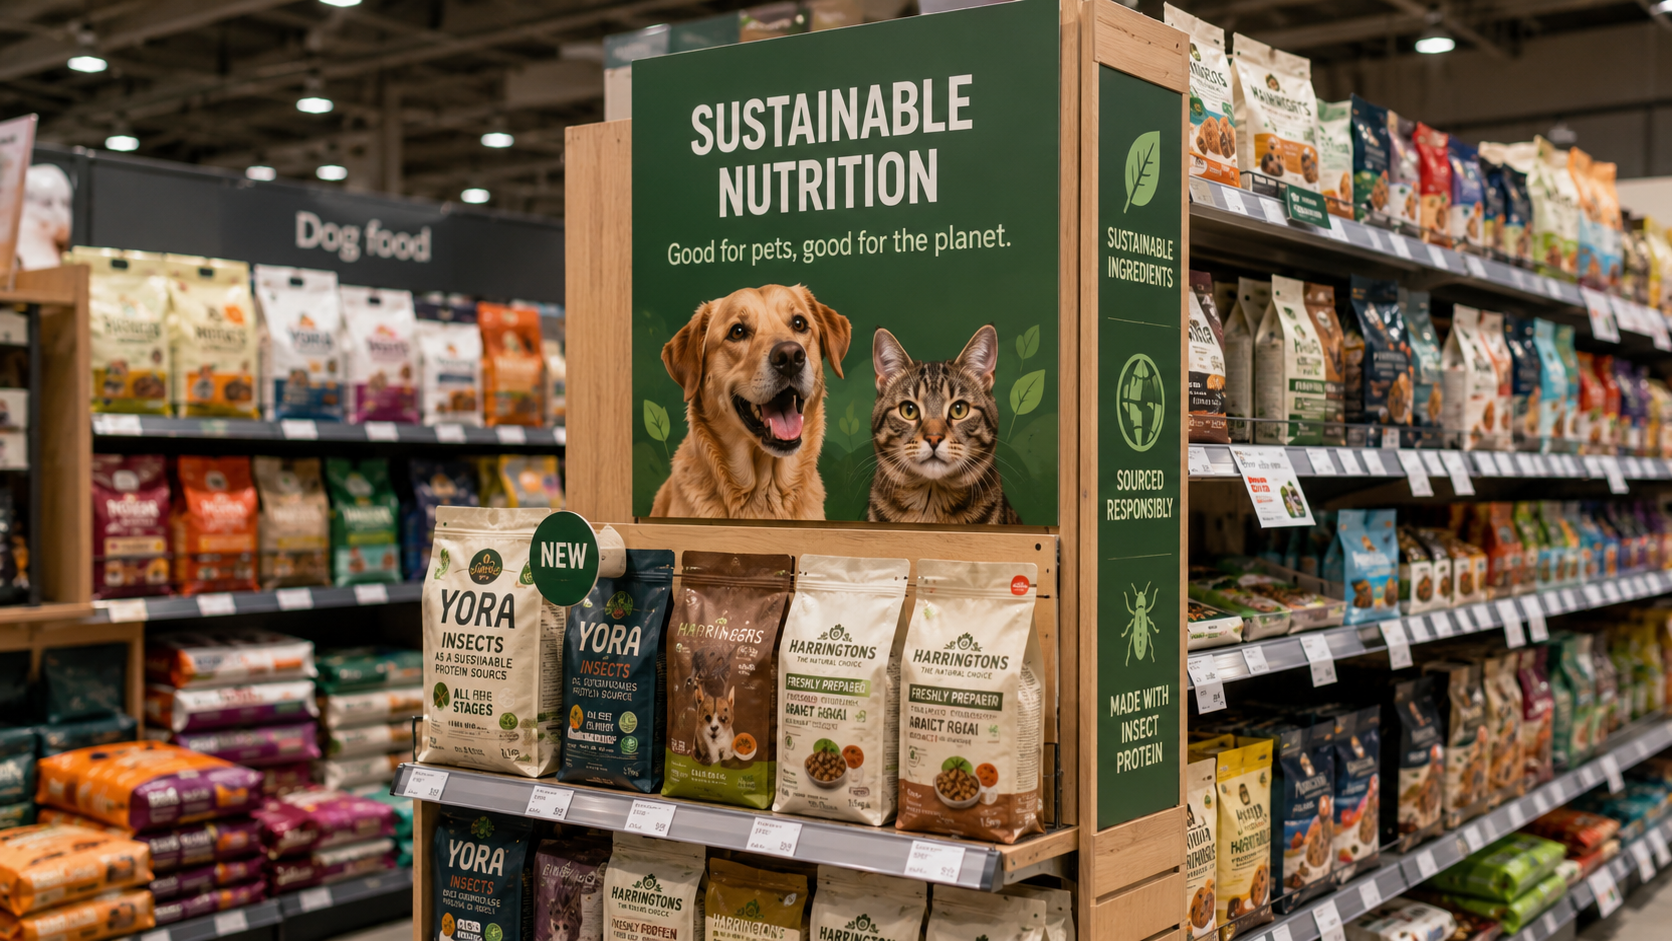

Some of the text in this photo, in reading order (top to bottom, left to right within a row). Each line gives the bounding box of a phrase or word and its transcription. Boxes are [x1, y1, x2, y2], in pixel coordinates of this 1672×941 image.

[691, 73, 973, 156] SUSTAINABLE
[719, 148, 938, 218] NUTRITION
[296, 210, 432, 263] Dog food
[667, 223, 1011, 266] Good for pets, good for the planet.
[1107, 226, 1173, 261] SUSTAINABLE
[1107, 255, 1173, 288] INGREDIENTS
[1116, 469, 1164, 491] SOURCED
[1106, 497, 1174, 521] RESPONSIBLY
[541, 541, 588, 569] NEW
[441, 589, 515, 629] YORA
[441, 632, 504, 653] INSECTS
[579, 621, 642, 656] YORA
[789, 639, 877, 660] HARRINGTONS
[446, 653, 452, 662] A
[580, 660, 631, 679] INSECTS
[912, 649, 1010, 670] HARRINGTONS
[435, 664, 468, 677] PROTEIN
[921, 666, 933, 674] THE
[967, 671, 993, 680] CHOICE
[453, 688, 470, 701] ALL
[787, 676, 820, 690] FRESHLY
[911, 687, 949, 703] FRESHLY
[453, 701, 493, 716] STAGES
[1110, 684, 1169, 717] MADE WITH
[1121, 714, 1159, 744] INSECT
[1116, 741, 1163, 774] PROTEIN
[448, 839, 505, 877] YORA
[450, 874, 495, 895] INSECTS
[611, 886, 683, 911] HARRINGTONS
[820, 926, 896, 941] HARRIN
